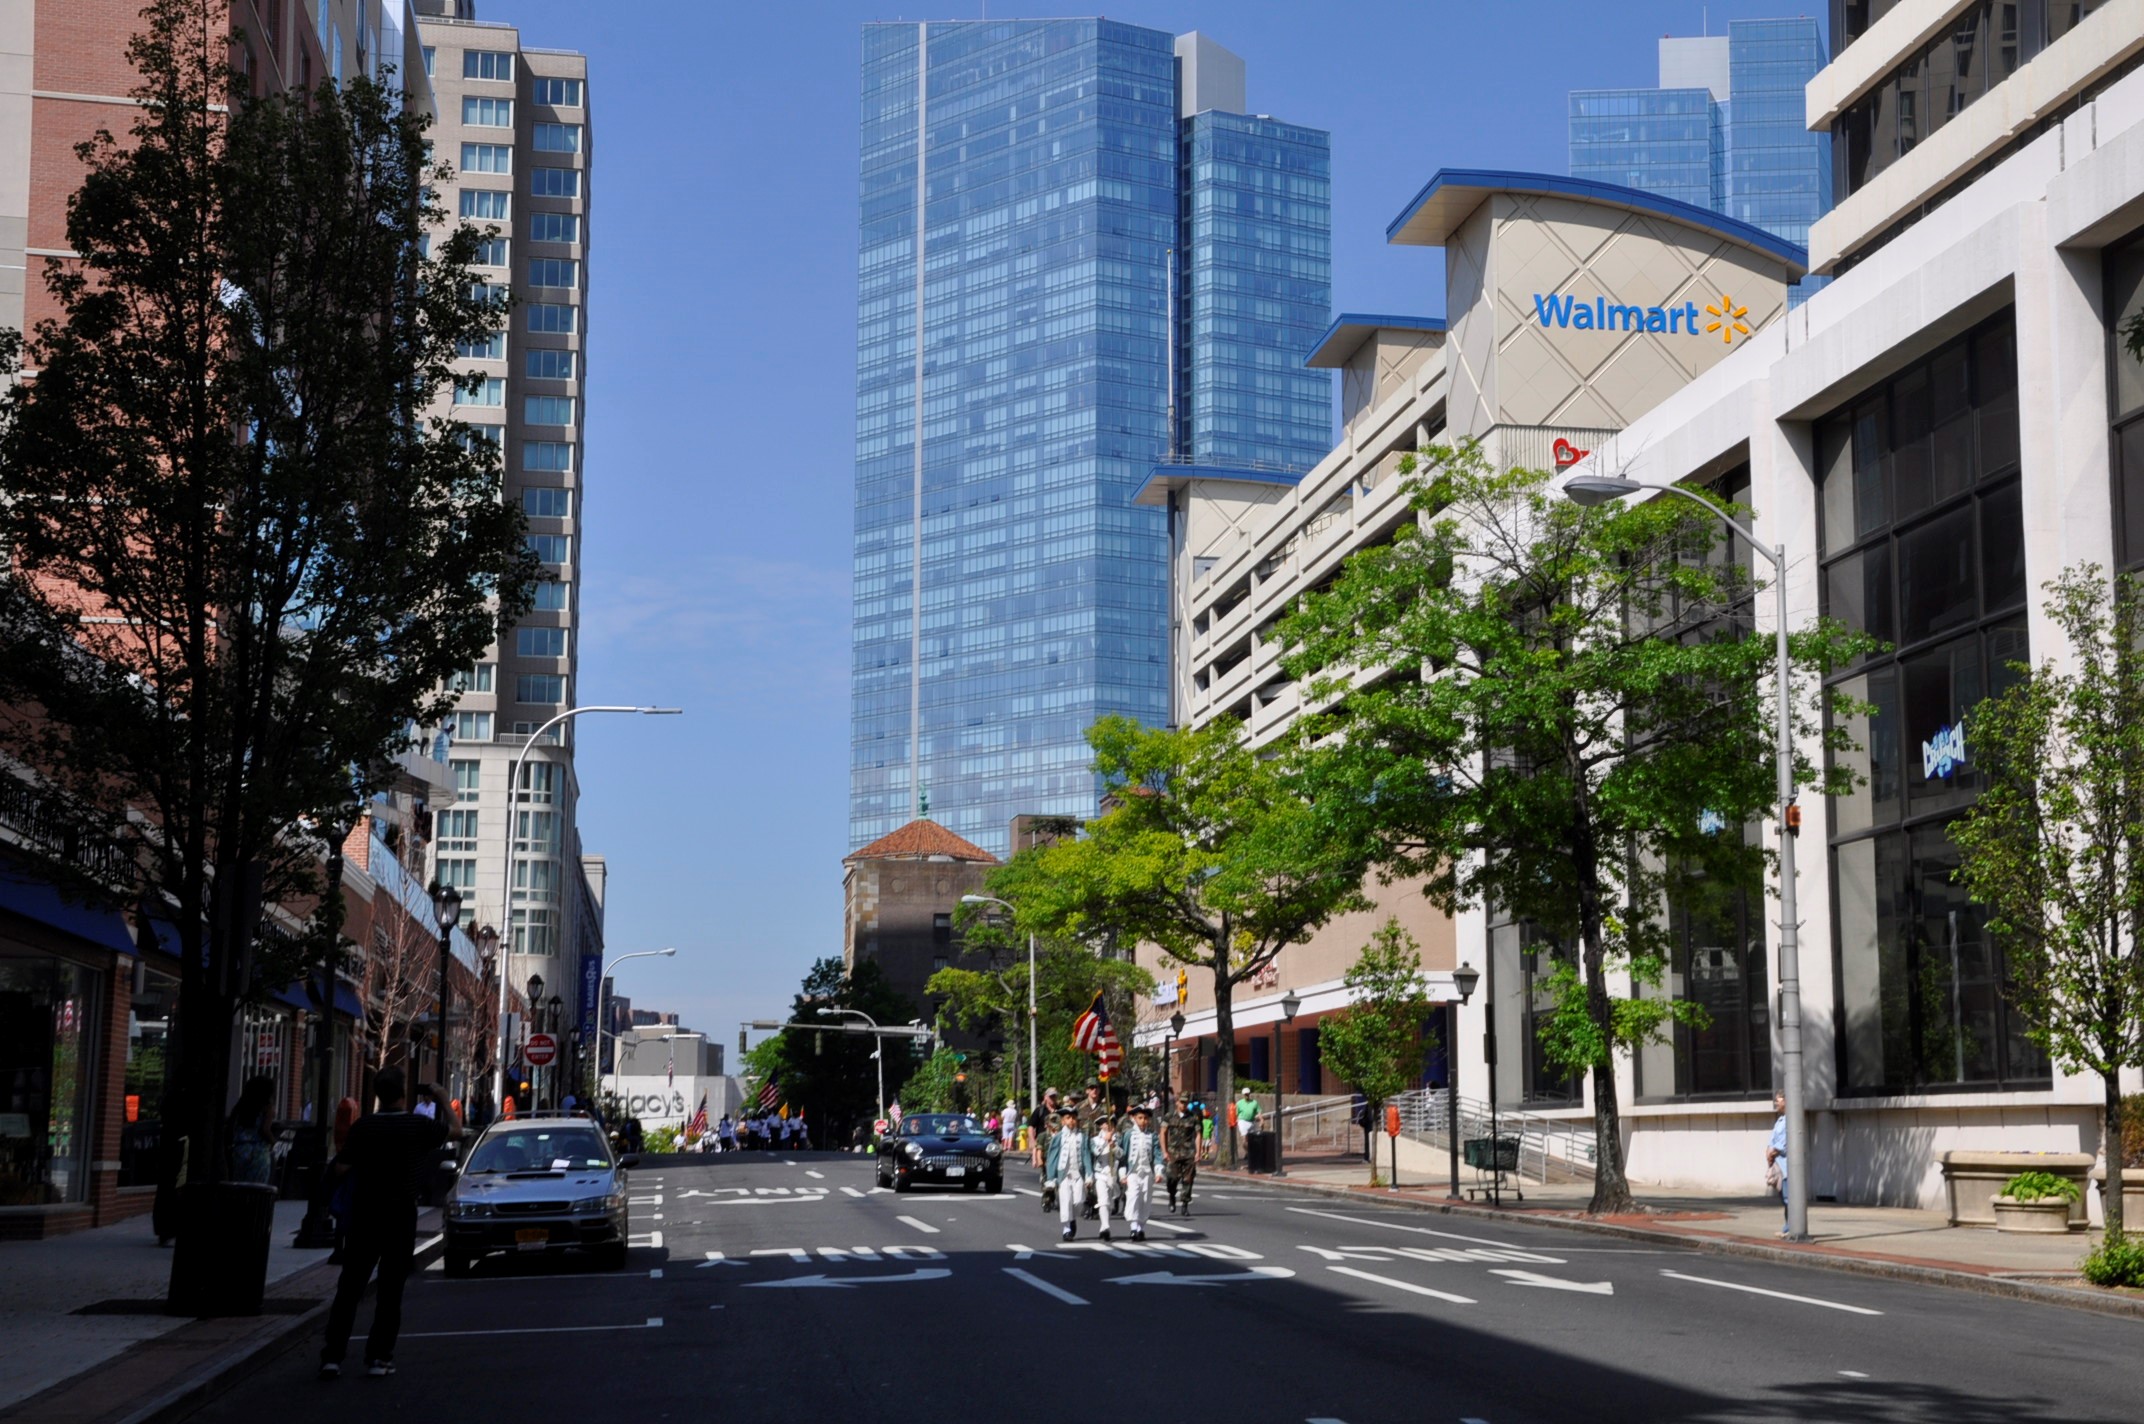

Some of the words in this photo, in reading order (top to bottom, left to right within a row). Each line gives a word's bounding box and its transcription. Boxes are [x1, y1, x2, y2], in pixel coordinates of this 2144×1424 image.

[1533, 293, 1699, 335] Walmart
[677, 1187, 830, 1198] ONLY
[695, 1245, 948, 1268] ONLY
[1005, 1243, 1264, 1260] ONLY
[1296, 1245, 1568, 1263] ONLY
